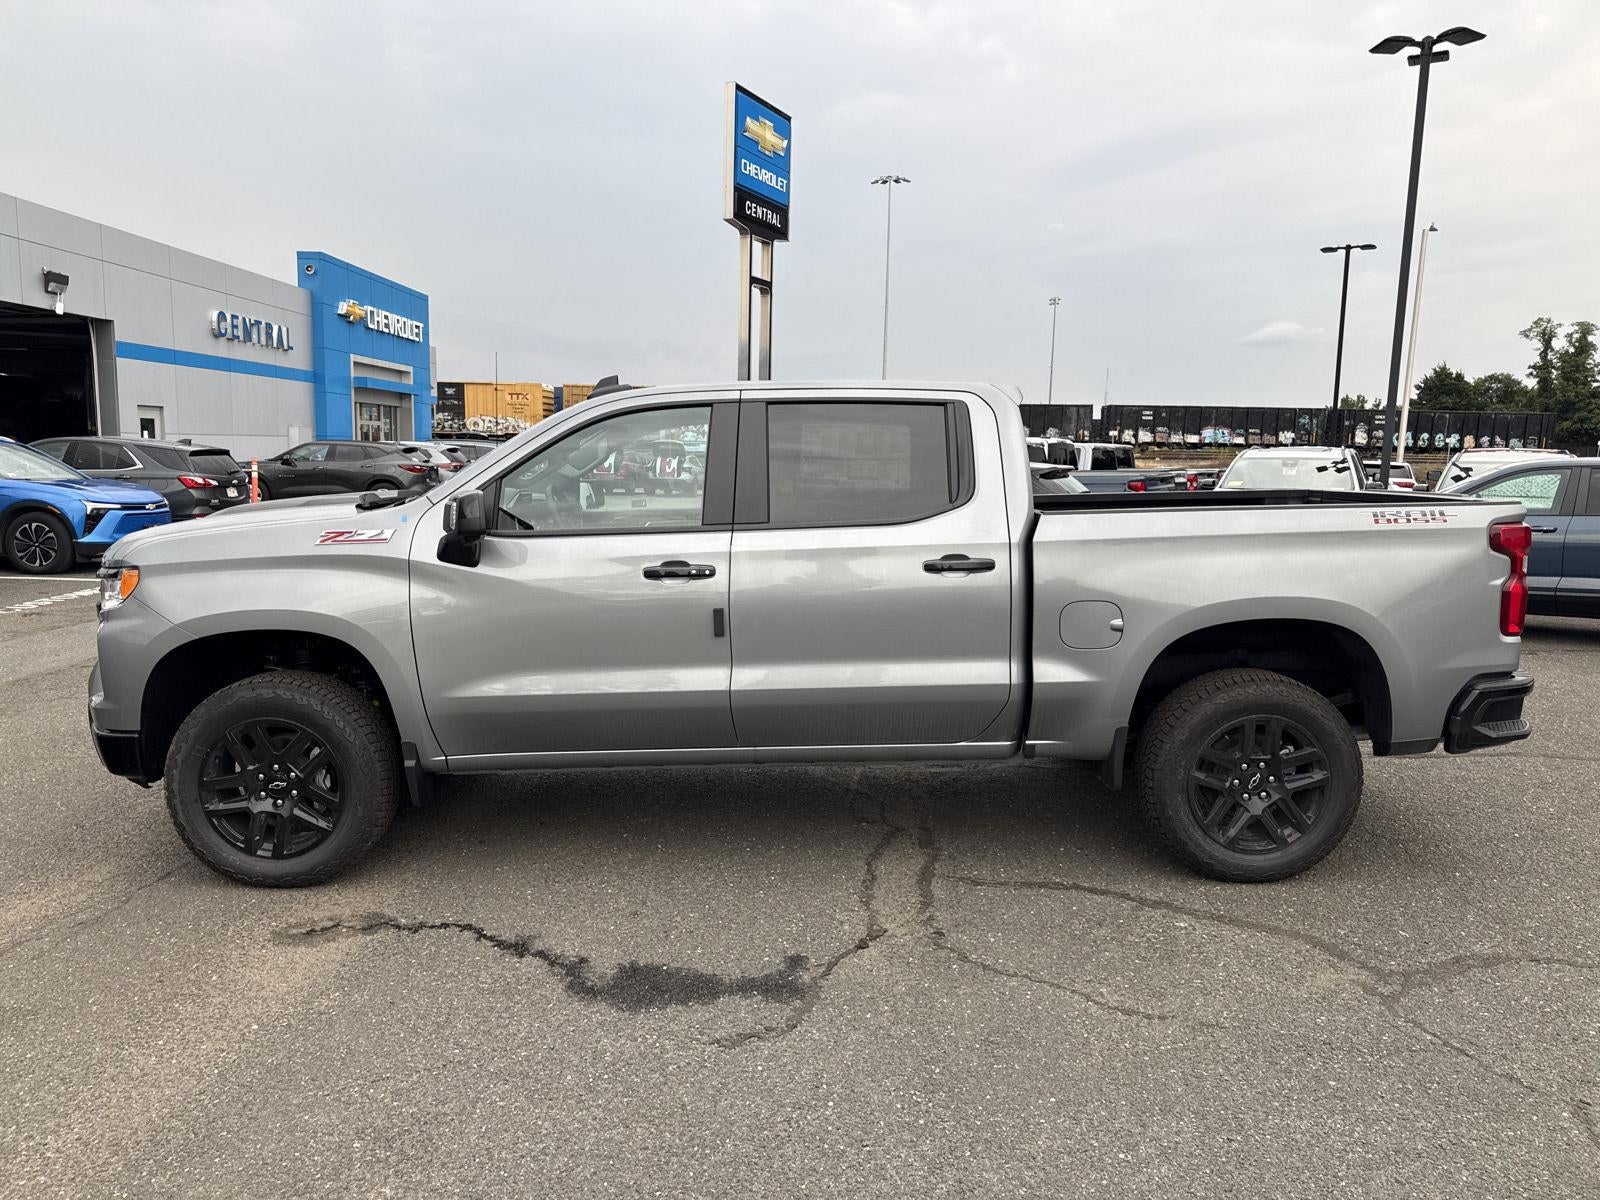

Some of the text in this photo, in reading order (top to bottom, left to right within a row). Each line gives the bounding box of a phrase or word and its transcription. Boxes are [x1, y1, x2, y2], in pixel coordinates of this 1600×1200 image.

[741, 158, 788, 193] CHEVROLET
[745, 200, 781, 228] CENTRAL
[212, 310, 294, 351] CENTRAL
[364, 305, 424, 342] CHEVROLET
[508, 392, 529, 400] TTX
[314, 529, 397, 545] Z71
